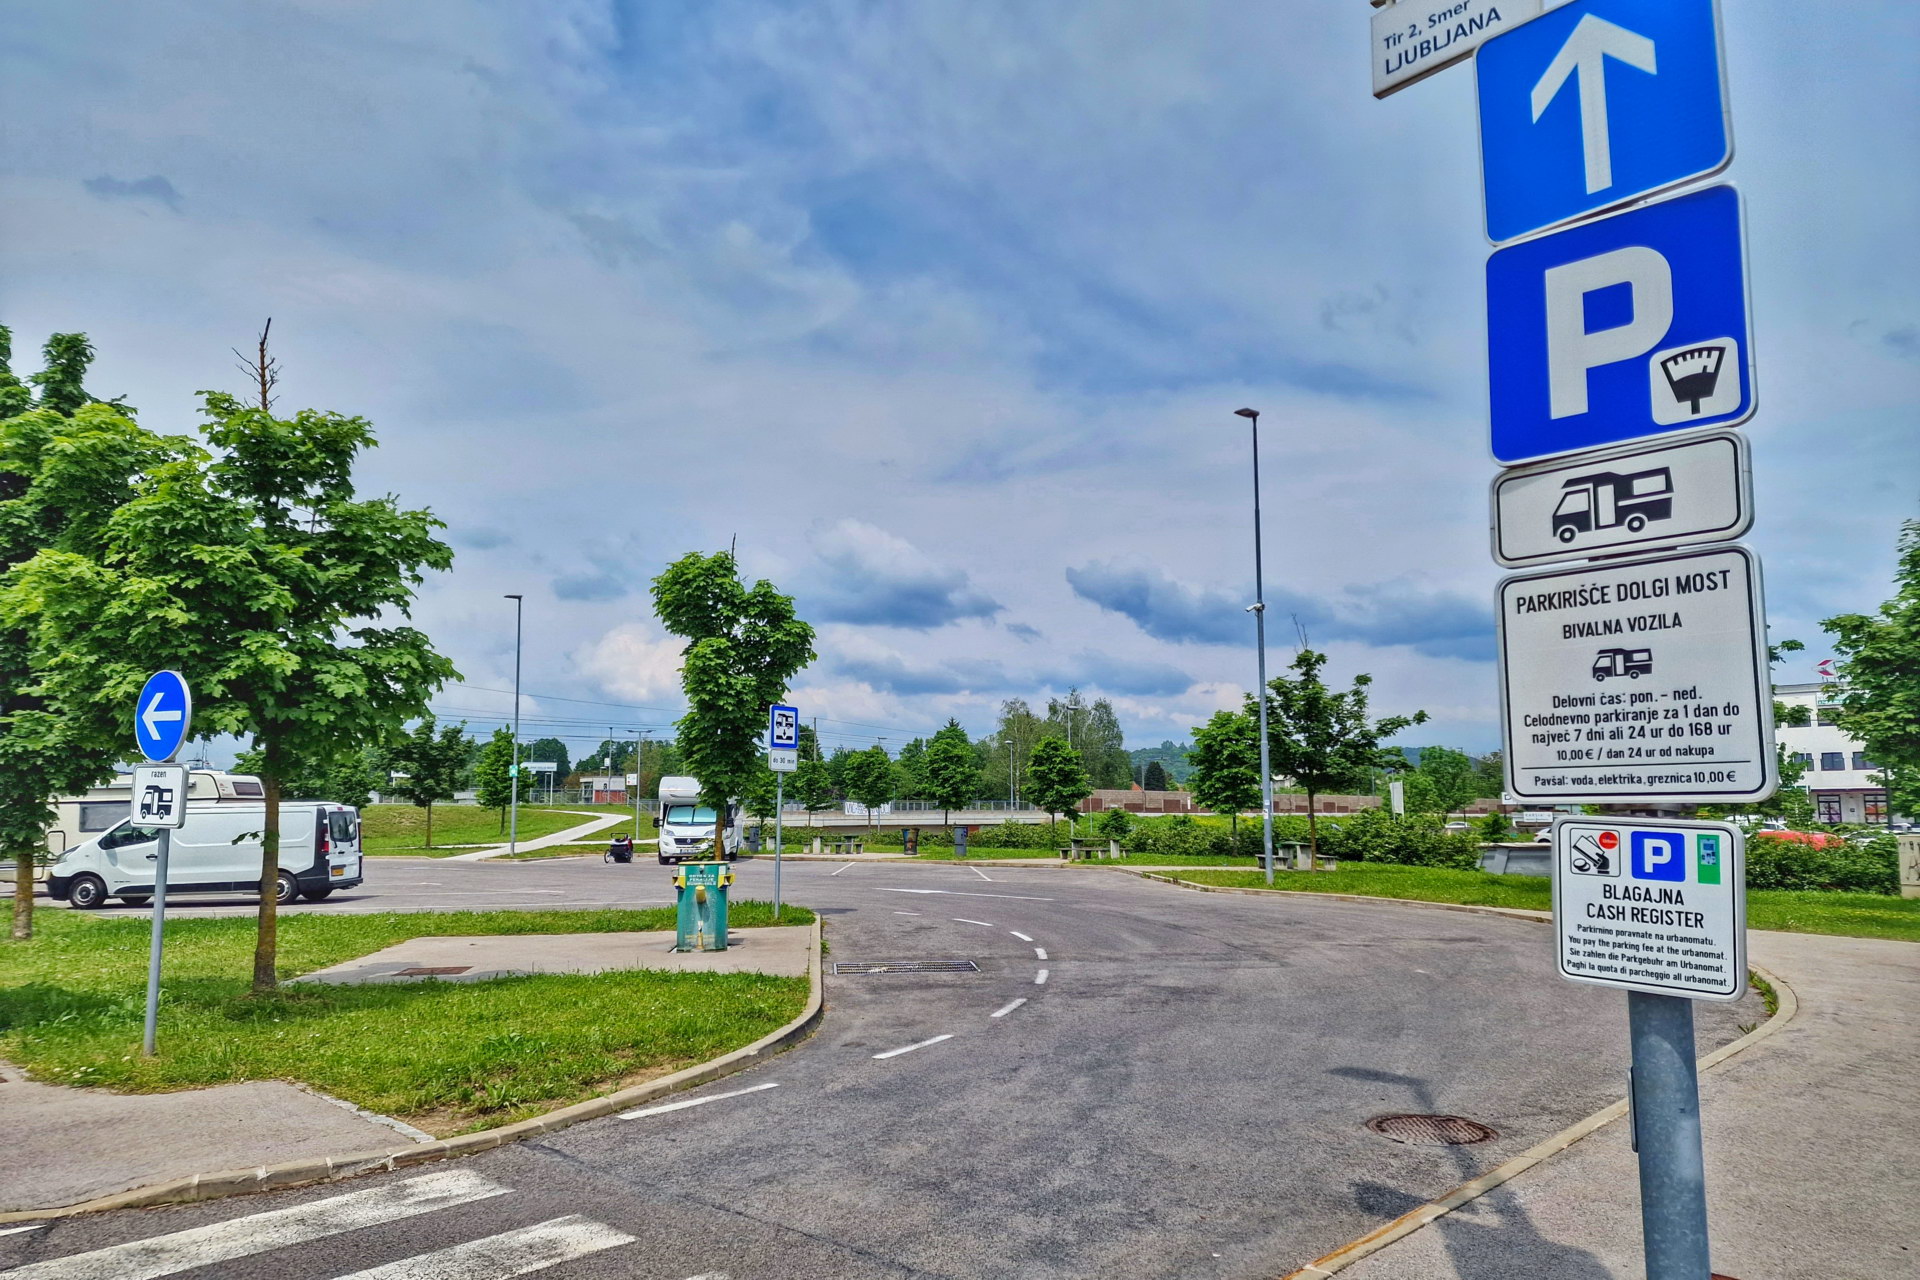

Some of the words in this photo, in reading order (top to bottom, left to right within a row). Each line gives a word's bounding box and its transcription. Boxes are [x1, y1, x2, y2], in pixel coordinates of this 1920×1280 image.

[1384, 32, 1404, 50] Tir
[1408, 23, 1422, 38] 2,
[1428, 0, 1470, 29] Smer
[1385, 6, 1502, 75] LJUBLJANA
[1545, 246, 1674, 420] P
[1516, 583, 1611, 614] PARKIRIŠČE
[1617, 578, 1670, 602] DOLGI
[1676, 569, 1731, 595] MOST
[1562, 618, 1623, 639] BIVALNA
[1627, 612, 1683, 632] VOZILA
[1552, 692, 1596, 709] Delovni
[1600, 692, 1626, 706] čas:
[1630, 691, 1658, 707] pon.
[1673, 685, 1702, 701] ned.
[1524, 713, 1591, 728] Celodnevno
[1594, 707, 1659, 726] parkiranje
[1663, 708, 1679, 719] za
[1683, 704, 1689, 718] 1
[1694, 703, 1718, 718] dan
[1723, 701, 1740, 716] do
[1532, 729, 1571, 747] največ
[1574, 728, 1582, 742] 7
[1586, 727, 1605, 742] dni
[1609, 726, 1624, 741] ali
[1628, 725, 1646, 739] 24
[1650, 727, 1664, 739] ur
[1668, 723, 1685, 738] do
[1688, 721, 1713, 737] 168
[1717, 724, 1732, 736] ur
[1606, 748, 1625, 759] dan
[1628, 747, 1642, 758] 24
[1645, 748, 1656, 758] ur
[1659, 746, 1672, 758] od
[1675, 744, 1715, 759] nakupa
[150, 770, 167, 778] razen
[1534, 775, 1569, 787] Pavšal:
[1647, 772, 1692, 787] greznica
[1643, 838, 1672, 873] P
[1602, 883, 1685, 906] BLAGAJNA
[1586, 902, 1626, 922] CASH
[1631, 907, 1705, 929] REGISTER
[1568, 935, 1581, 944] You
[1583, 938, 1596, 948] pay
[1598, 938, 1610, 948] the
[1612, 941, 1640, 952] parking
[1642, 943, 1654, 953] fee
[1656, 945, 1664, 954] at
[1667, 945, 1680, 955] the
[1681, 947, 1728, 961] urbanomat.
[1577, 923, 1614, 935] Parkirnino
[1615, 929, 1653, 940] poravnate
[1655, 932, 1664, 941] na
[1666, 933, 1717, 947] urbanomatu.
[1566, 959, 1587, 971] Paghi
[1588, 962, 1596, 971] la
[1597, 964, 1618, 974] quota
[1620, 966, 1627, 975] di
[1628, 968, 1670, 981] parcheggio
[1672, 972, 1682, 982] all
[1684, 974, 1731, 987] urbanomat.
[1569, 947, 1580, 956] Sie
[1582, 949, 1606, 960] zahlen
[1608, 951, 1619, 961] die
[1666, 960, 1678, 968] am
[1680, 960, 1727, 973] Urbanomat.
